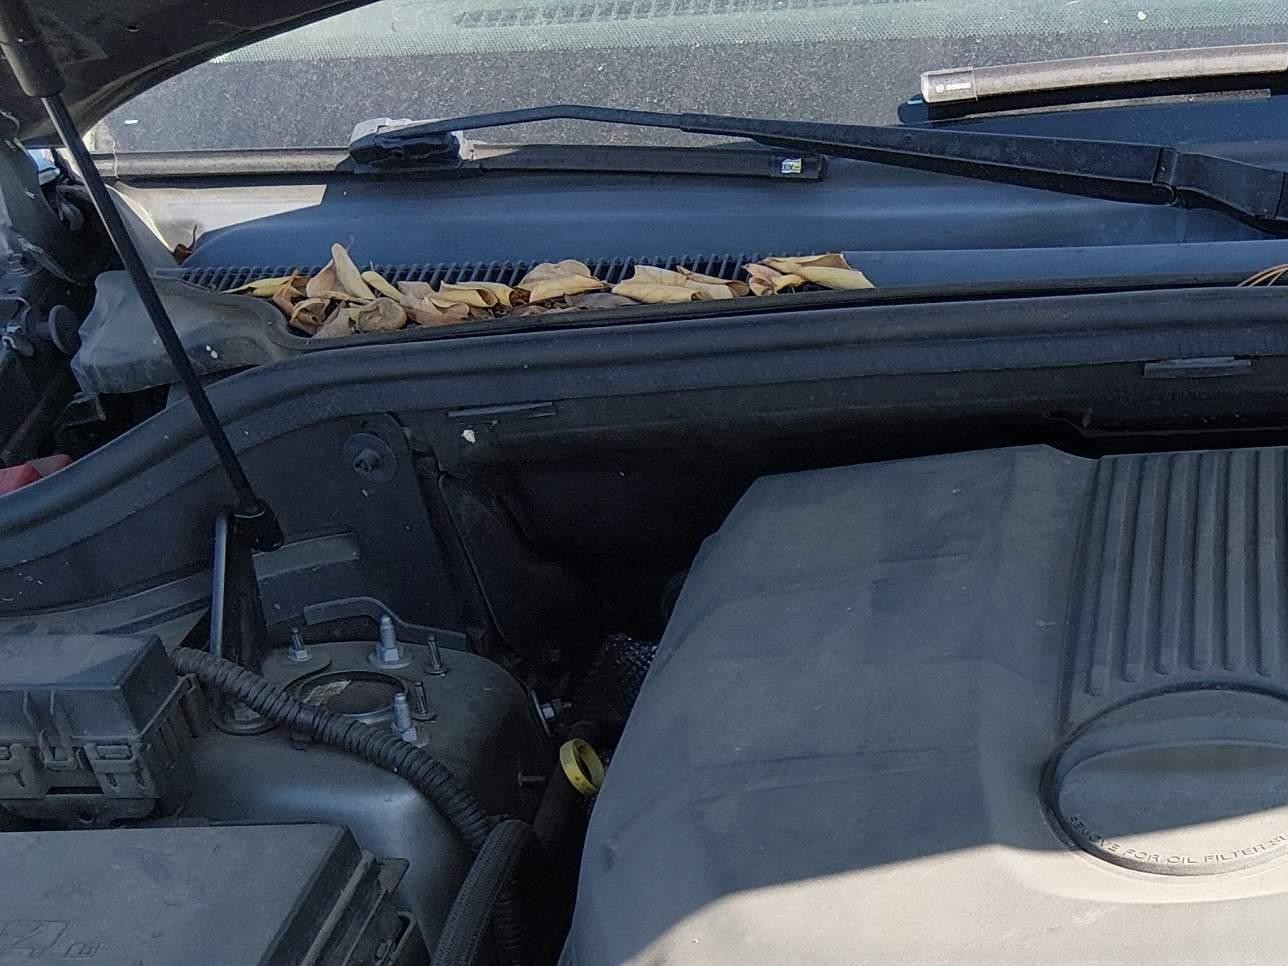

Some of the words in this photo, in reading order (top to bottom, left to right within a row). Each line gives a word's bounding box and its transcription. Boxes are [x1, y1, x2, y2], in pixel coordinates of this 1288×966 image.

[1123, 849, 1160, 863] FOR
[1166, 855, 1198, 864] OIL
[1204, 843, 1267, 862] FILTER
